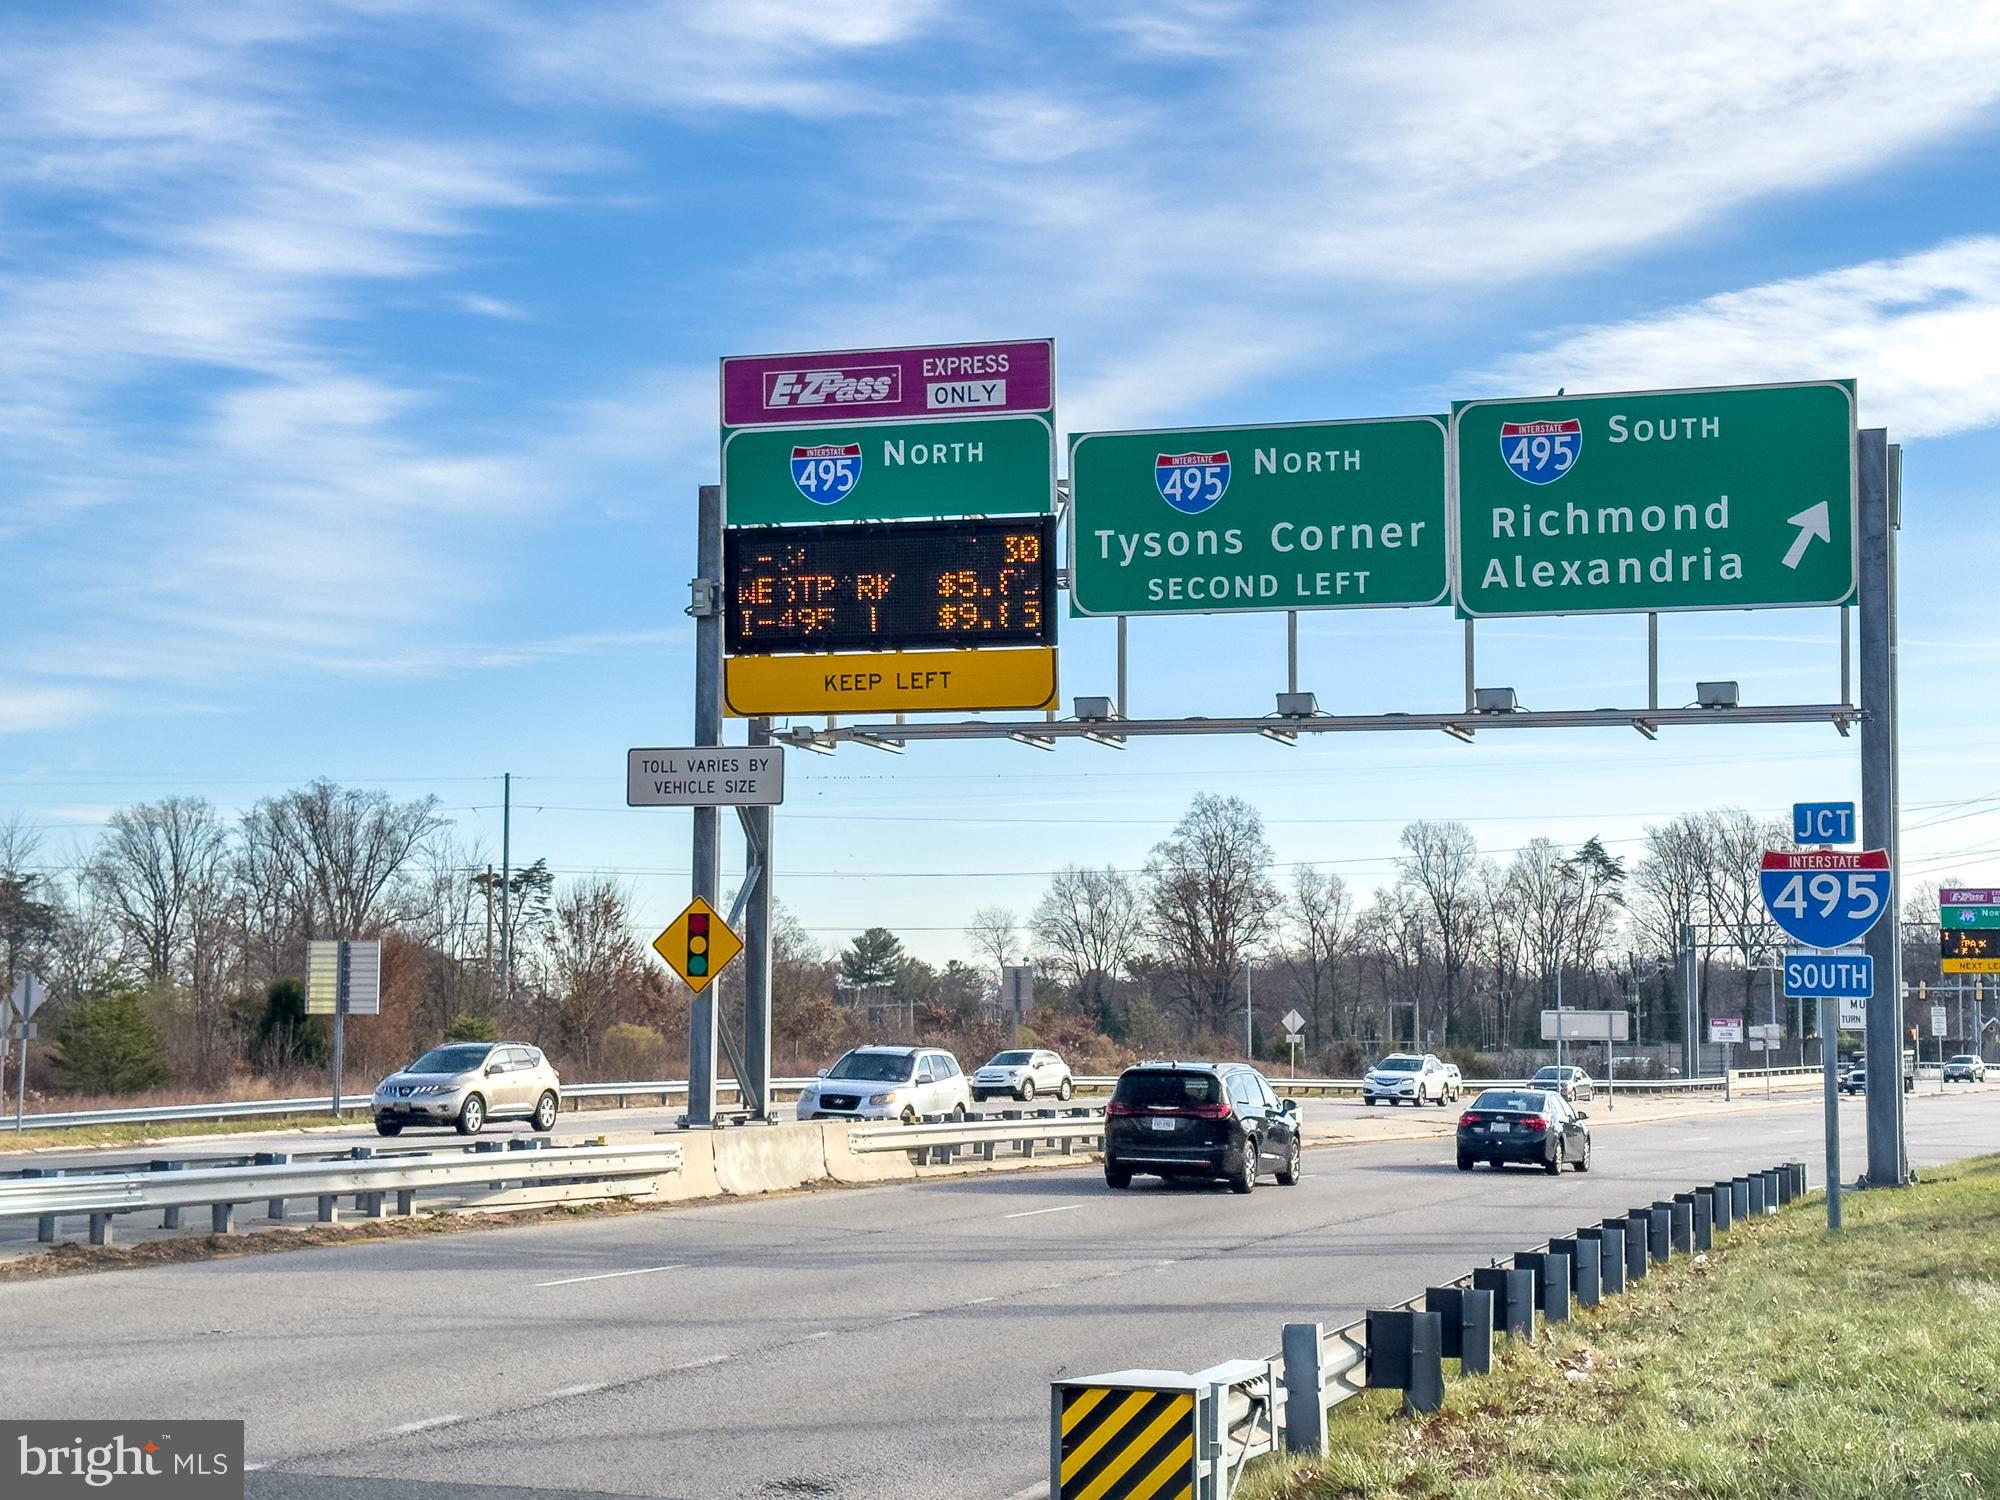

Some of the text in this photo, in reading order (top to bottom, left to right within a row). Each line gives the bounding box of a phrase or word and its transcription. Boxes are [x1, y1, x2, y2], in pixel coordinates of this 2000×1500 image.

[922, 354, 1010, 377] EXPRESS
[769, 371, 892, 406] E-ZPass
[935, 384, 997, 404] ONLY
[1518, 423, 1563, 434] INTERSTATE
[1608, 414, 1720, 443] SOUTH
[806, 447, 847, 458] INTERSTATE
[884, 439, 984, 467] NORTH
[1172, 455, 1213, 465] INTERSTATE
[1254, 447, 1361, 475] NORTH
[1509, 436, 1573, 472] 495
[799, 459, 854, 493] 495
[1163, 467, 1222, 501] 495
[1491, 495, 1728, 539] Richmond
[1094, 520, 1425, 566] Tysons Corner
[1481, 546, 1743, 589] Alexandria
[1148, 571, 1370, 601] SECOND LEFT
[824, 671, 952, 692] KEEP LEFT
[642, 758, 769, 774] TOLL VARIES BY
[654, 780, 757, 794] VEHICLE SIZE
[1798, 809, 1850, 838] JCT
[1788, 855, 1861, 869] INTERSTATE
[1773, 873, 1880, 920] 495
[1787, 963, 1868, 989] SOUTH
[1960, 962, 1983, 970] NEXT
[1842, 1015, 1861, 1023] TURN
